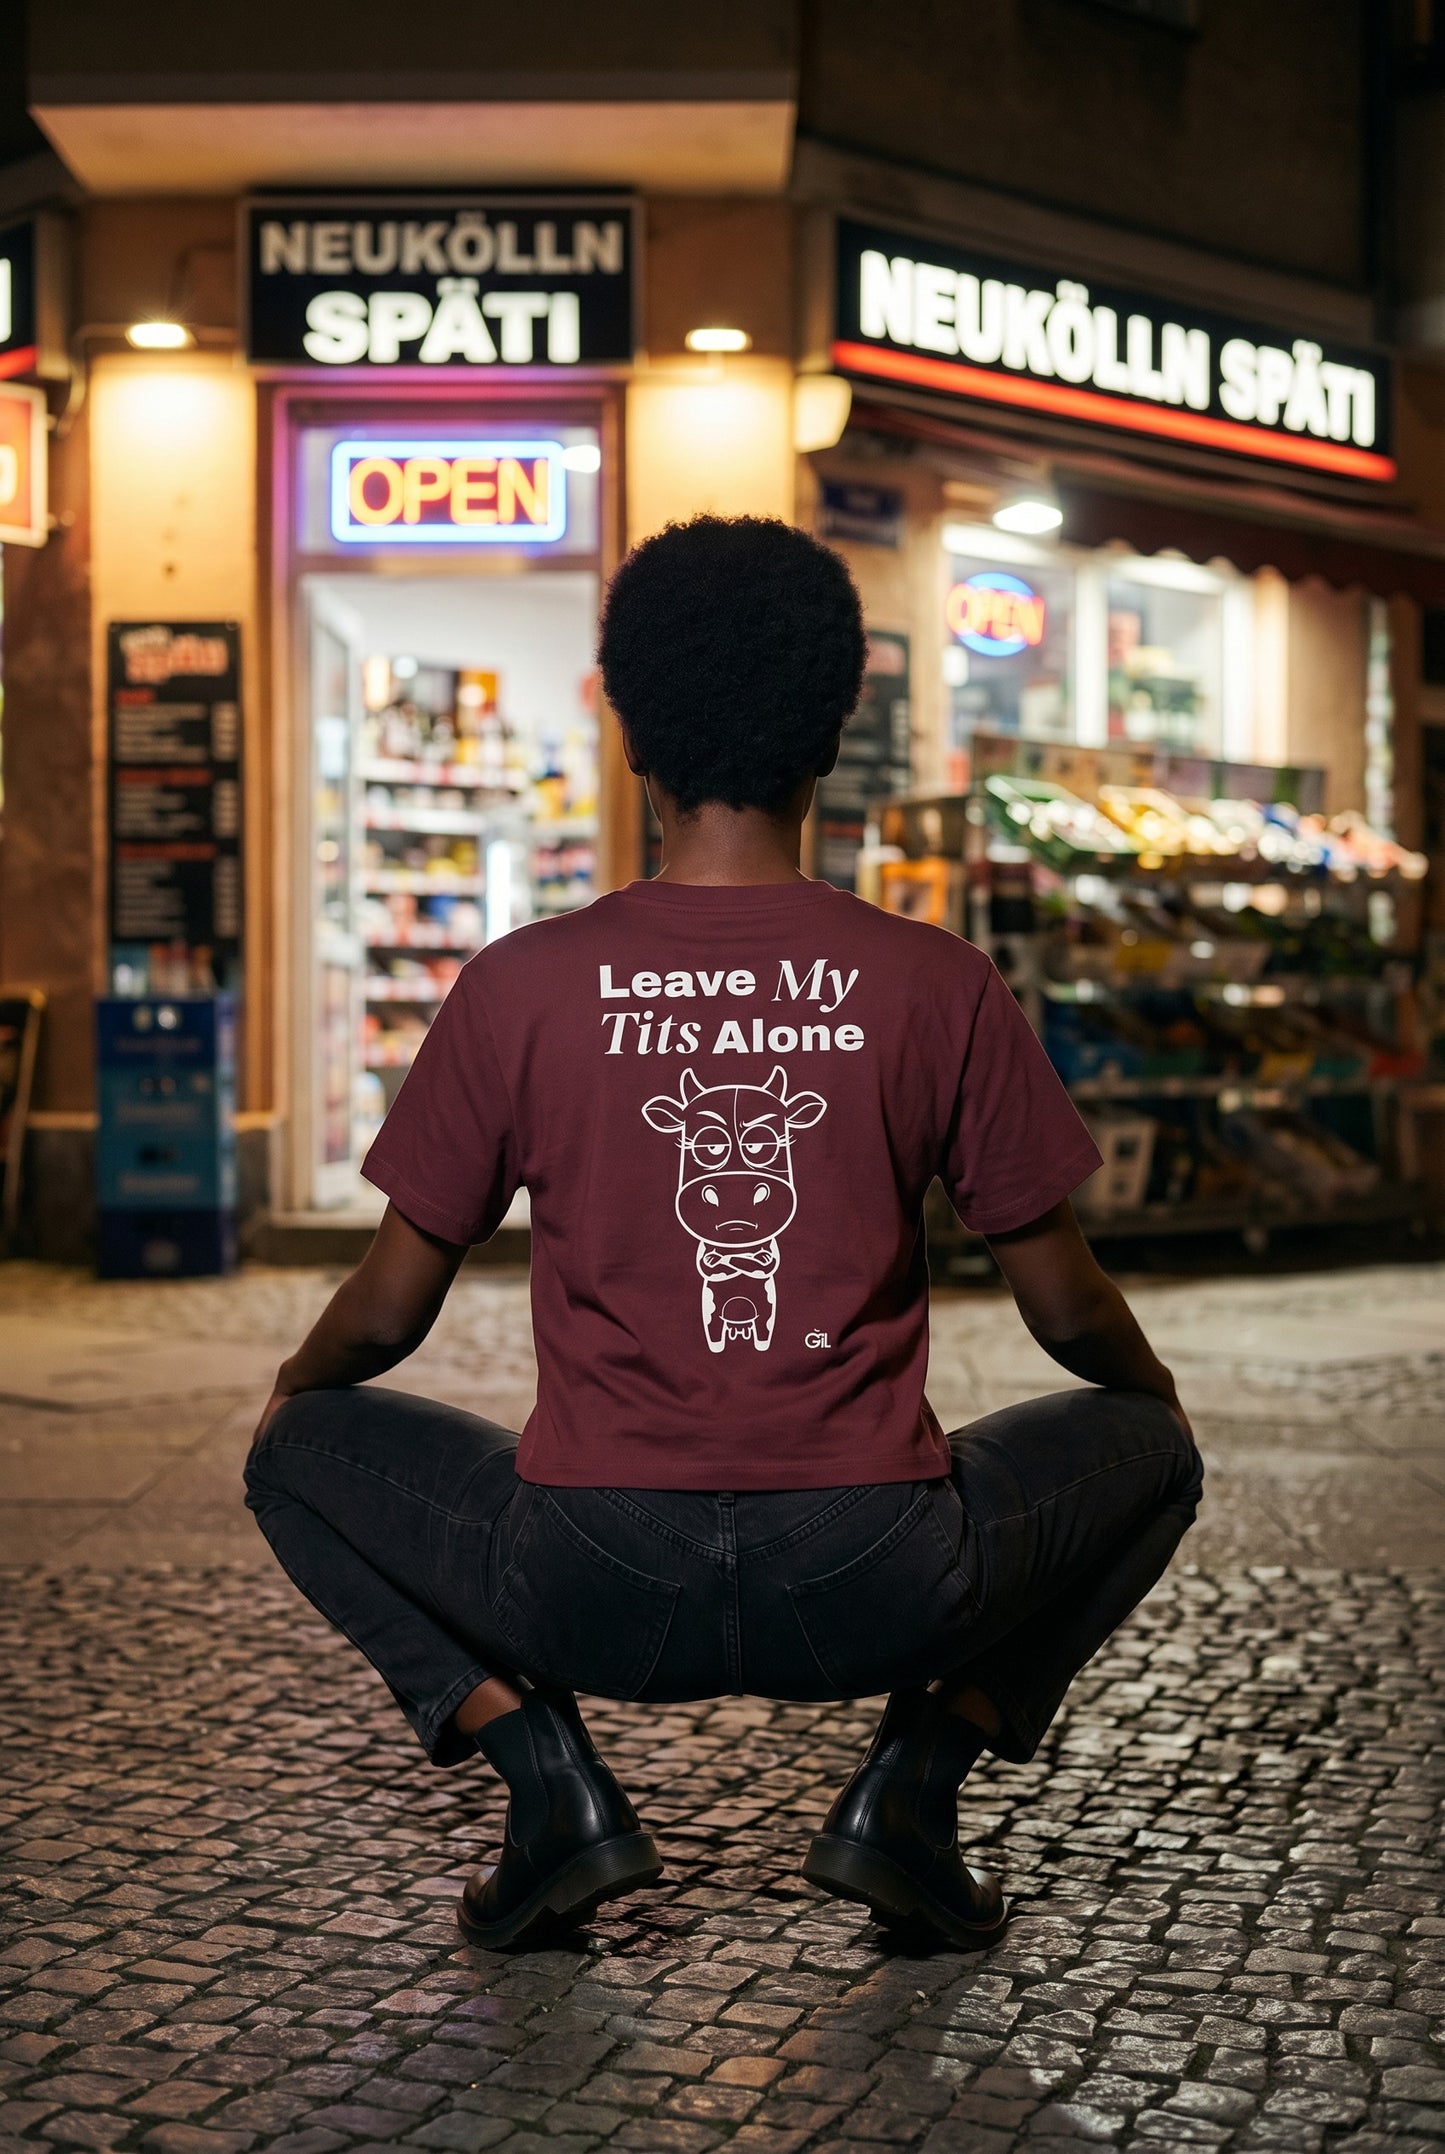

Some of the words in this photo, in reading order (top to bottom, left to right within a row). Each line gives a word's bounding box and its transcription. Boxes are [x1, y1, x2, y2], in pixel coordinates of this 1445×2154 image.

[260, 212, 623, 275] NEUKÖLLN
[303, 278, 580, 364] SPÄTI
[860, 250, 1211, 411] NEUKÖLLN
[1218, 340, 1376, 448] SPÄTI
[348, 457, 549, 527] OPEN
[947, 582, 1045, 646] OPEN
[600, 965, 756, 999] Leave
[771, 959, 859, 1013] My
[601, 1010, 702, 1055] Tits
[712, 1018, 865, 1054] Alone
